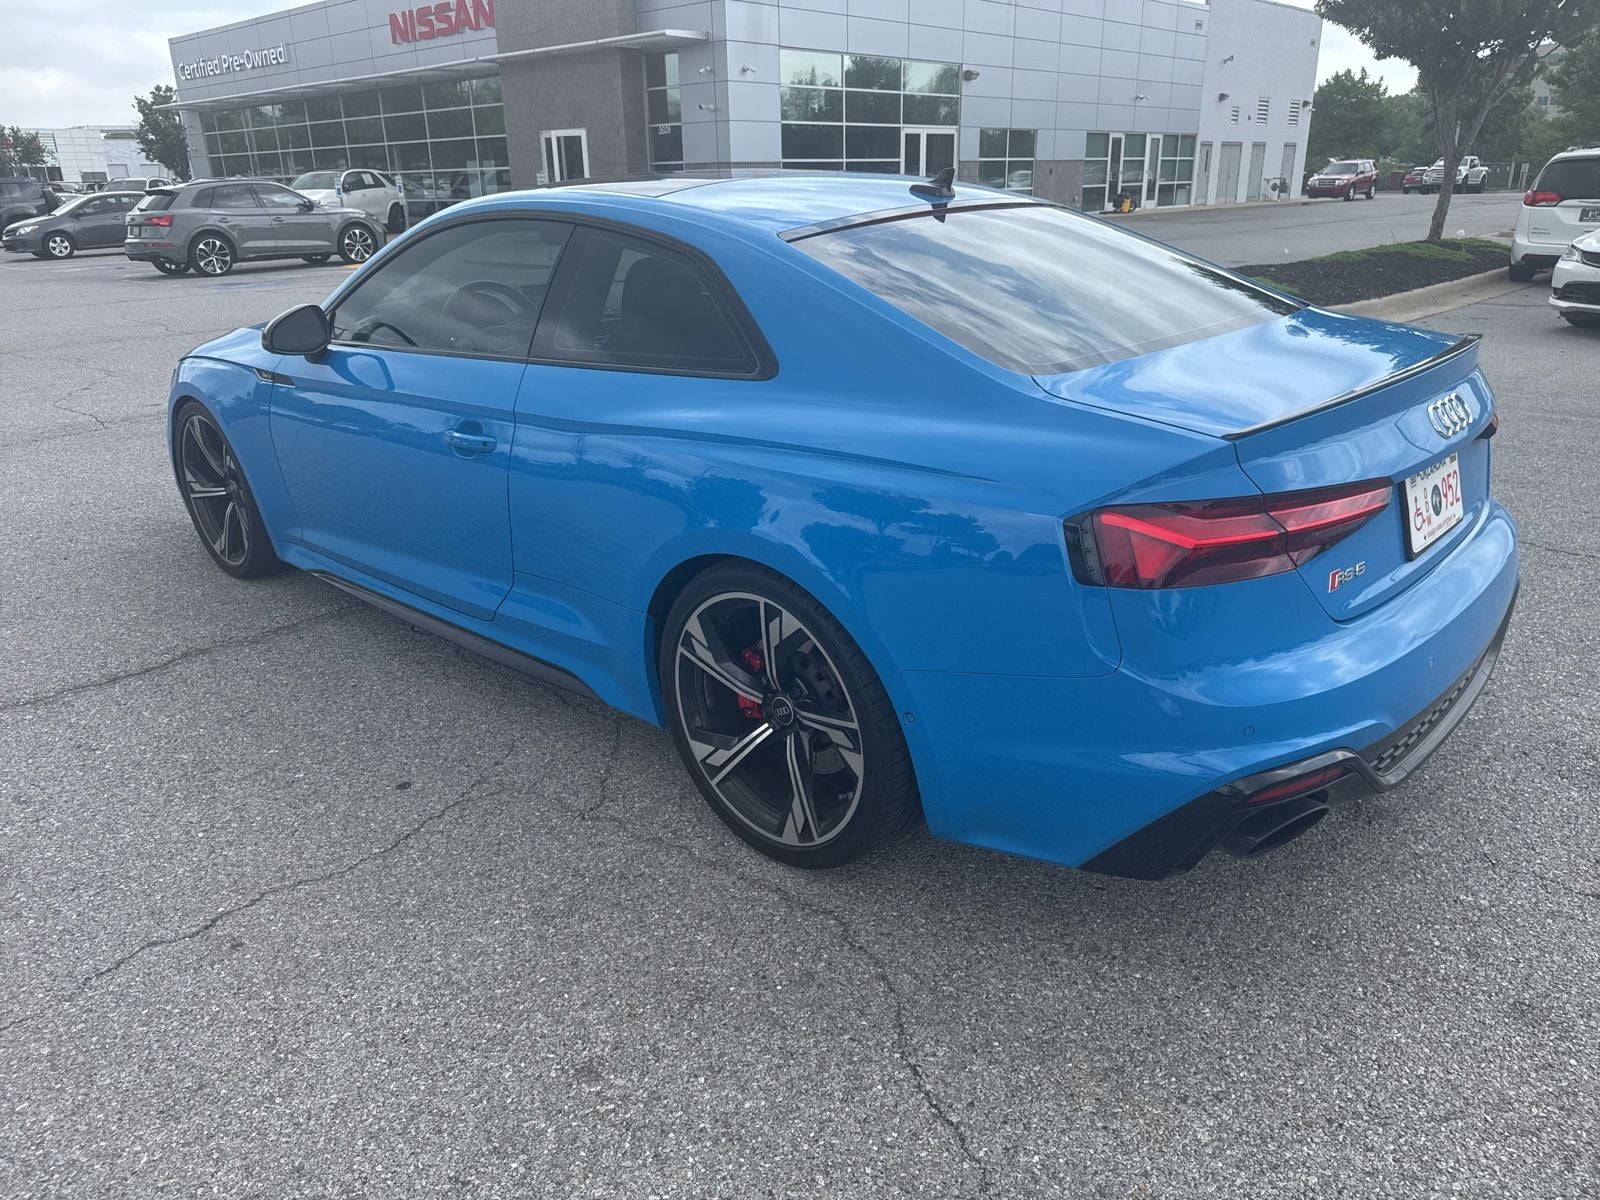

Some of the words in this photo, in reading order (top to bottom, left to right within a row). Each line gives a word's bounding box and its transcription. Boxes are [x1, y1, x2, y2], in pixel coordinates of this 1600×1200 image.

[389, 0, 496, 45] NISSAN
[178, 54, 221, 81] Certified
[220, 40, 286, 74] Pre-Owned
[1441, 469, 1461, 510] 952
